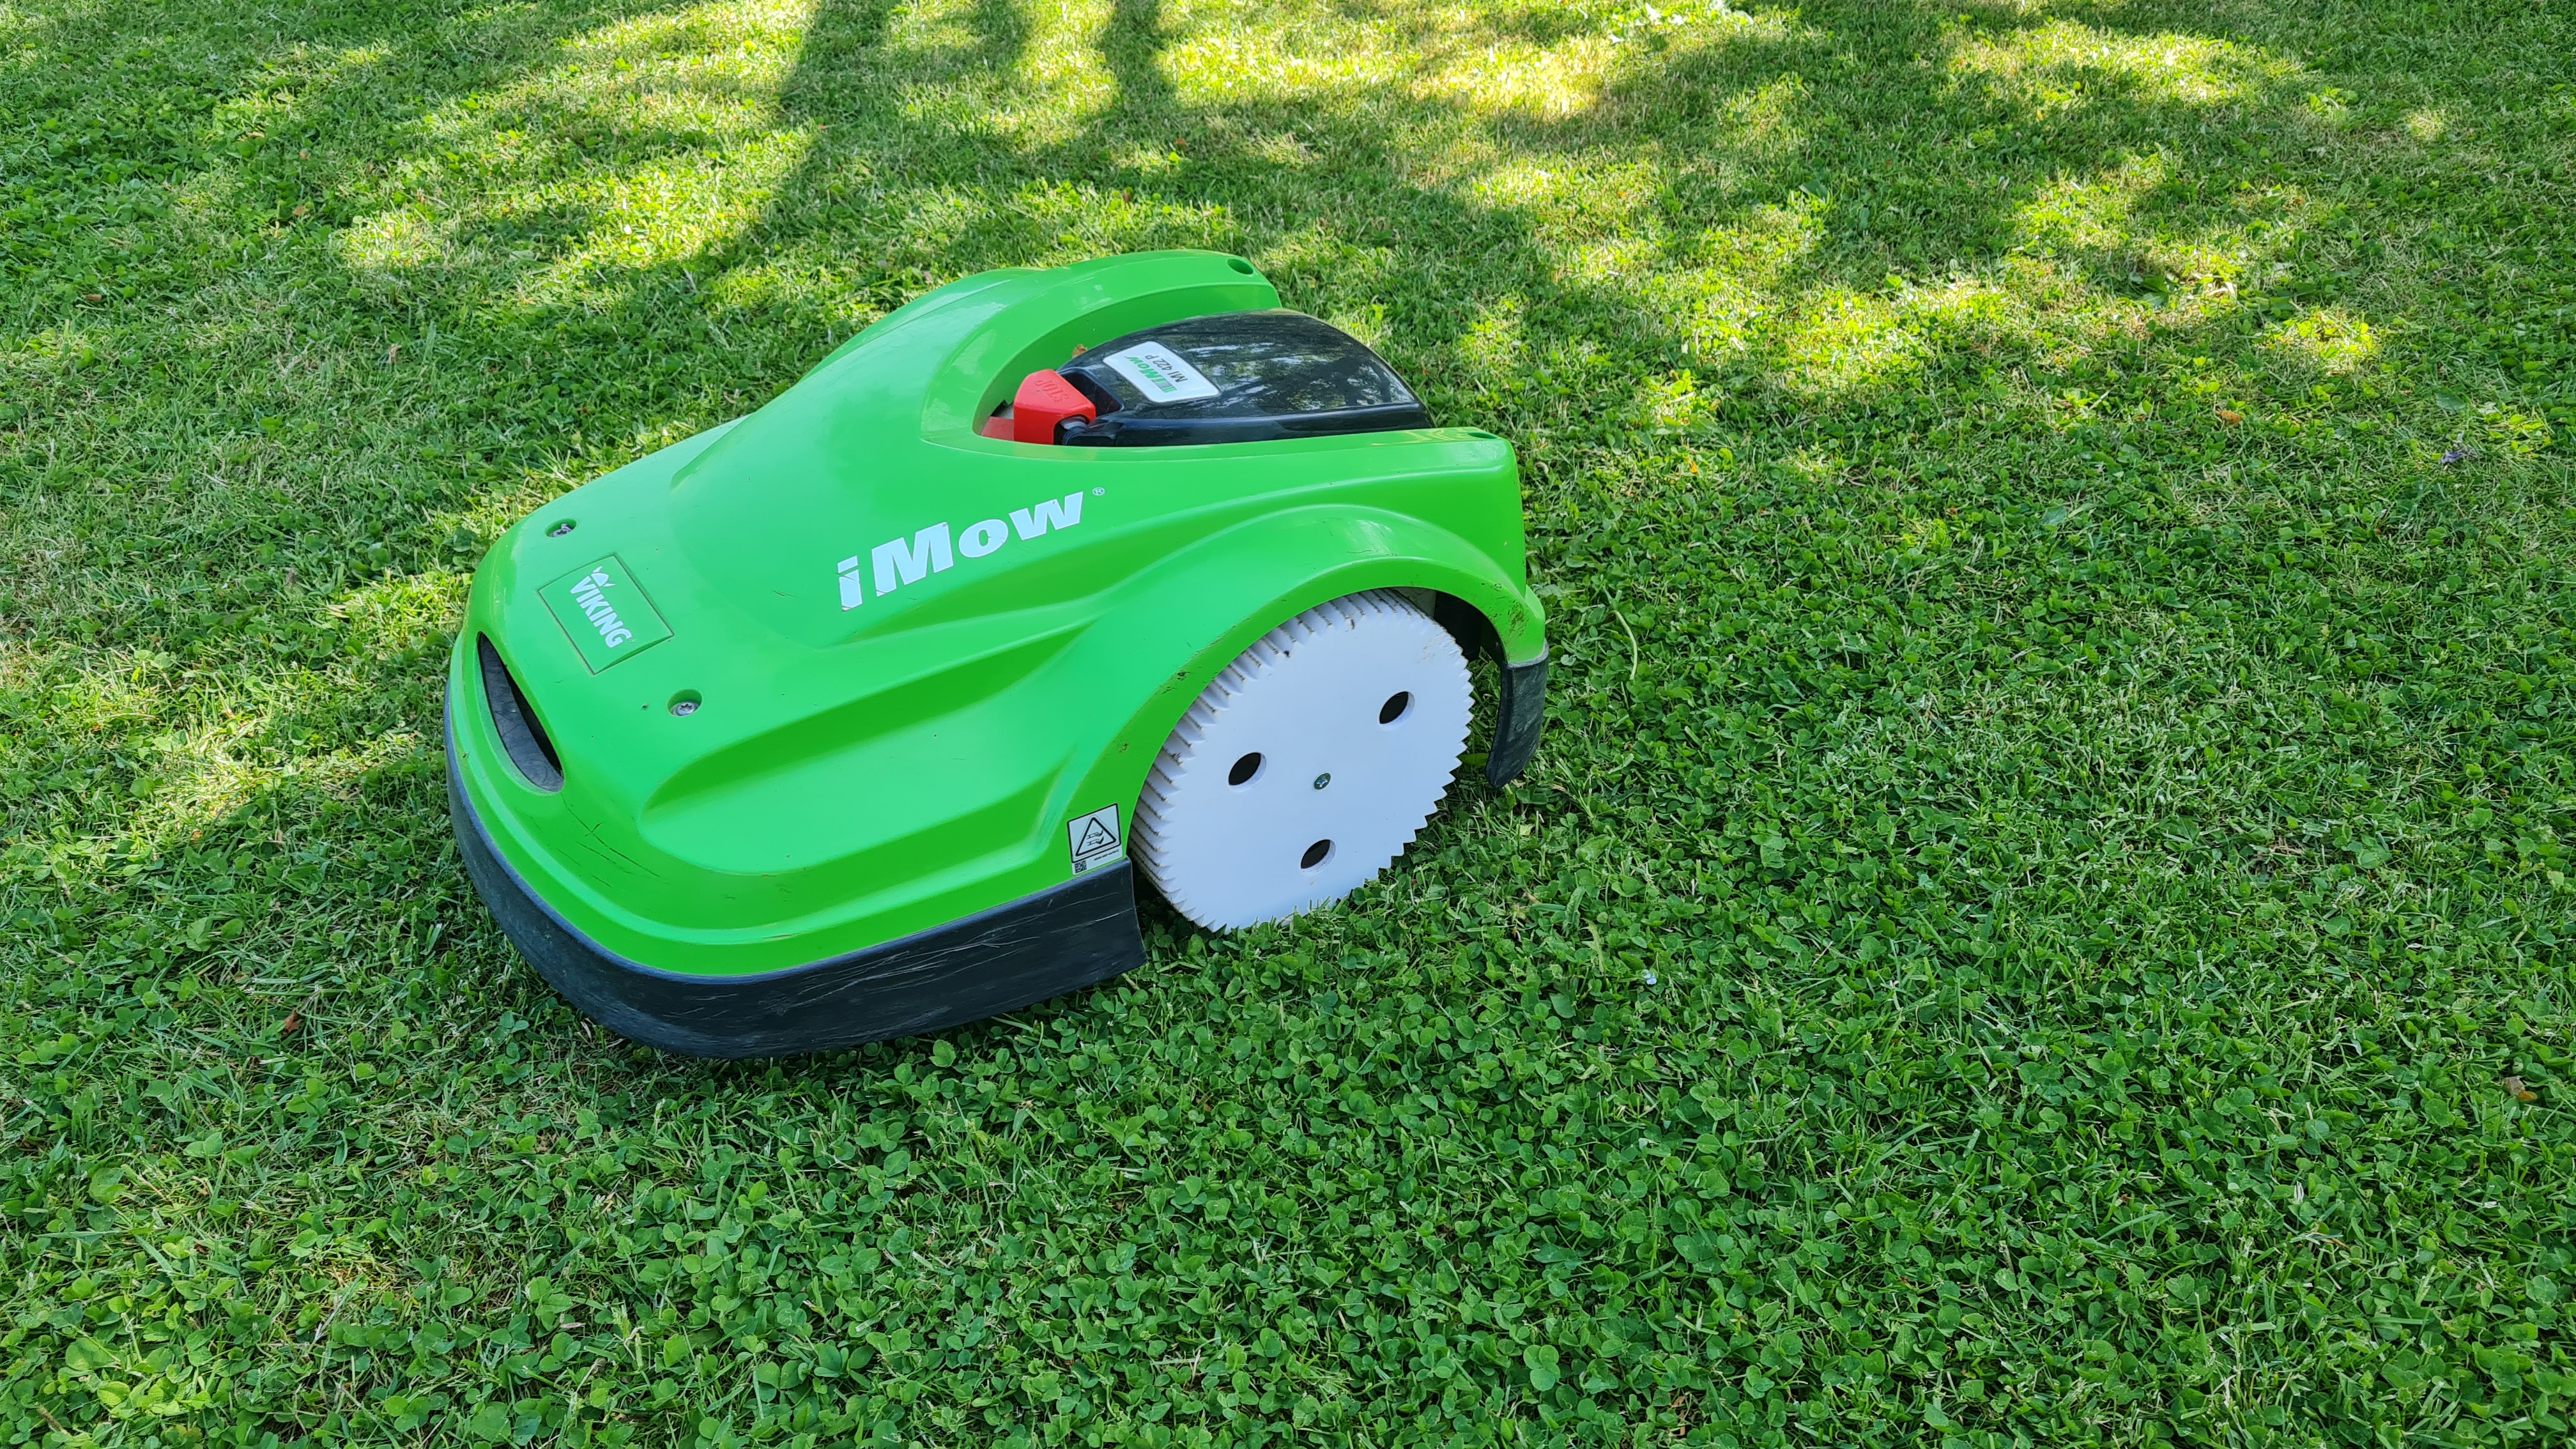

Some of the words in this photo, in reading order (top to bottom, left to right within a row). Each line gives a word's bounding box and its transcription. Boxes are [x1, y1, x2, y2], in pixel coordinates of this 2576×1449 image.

[1153, 358, 1173, 371] 422
[1034, 379, 1070, 402] STOP
[569, 575, 632, 648] VIKING
